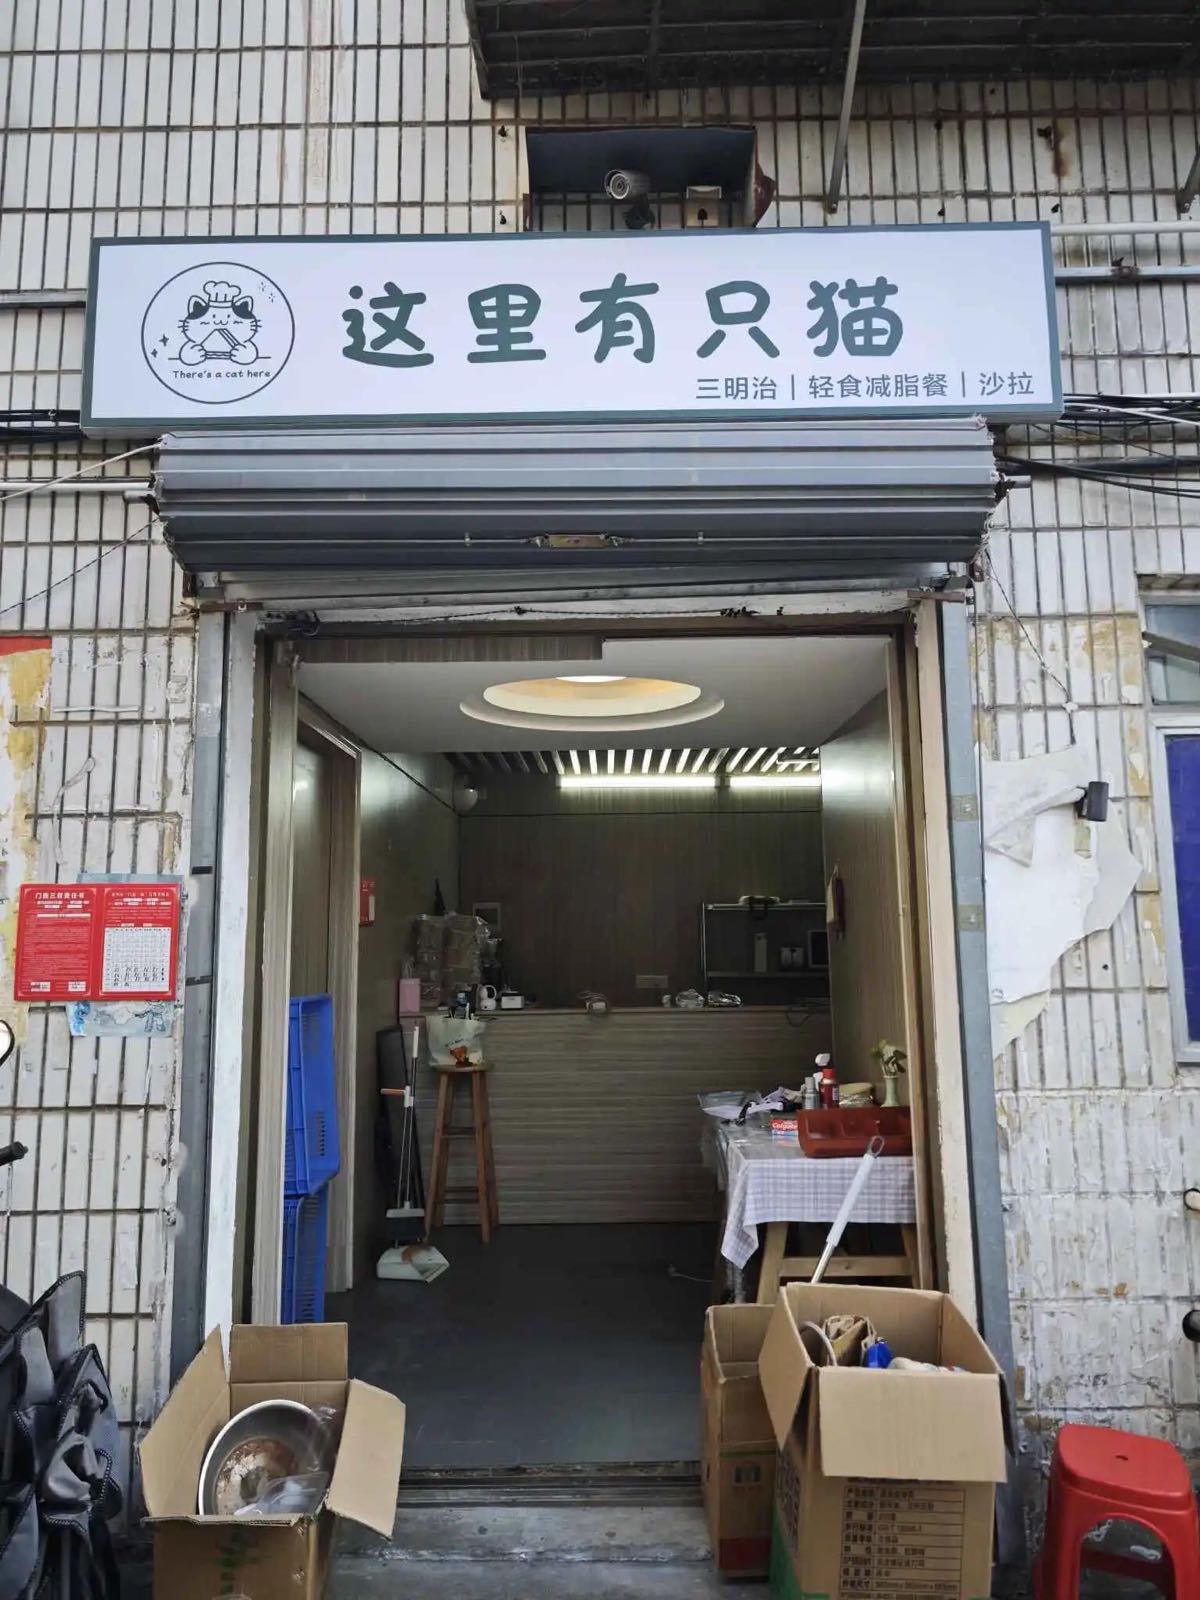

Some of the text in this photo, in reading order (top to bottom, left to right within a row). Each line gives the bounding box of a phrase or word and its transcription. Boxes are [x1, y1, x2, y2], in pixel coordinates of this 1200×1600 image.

[341, 272, 904, 368] 这里有只猫
[173, 370, 212, 379] There's
[247, 370, 271, 378] here
[696, 371, 1035, 400] 三明治 轻食减脂餐 沙拉
